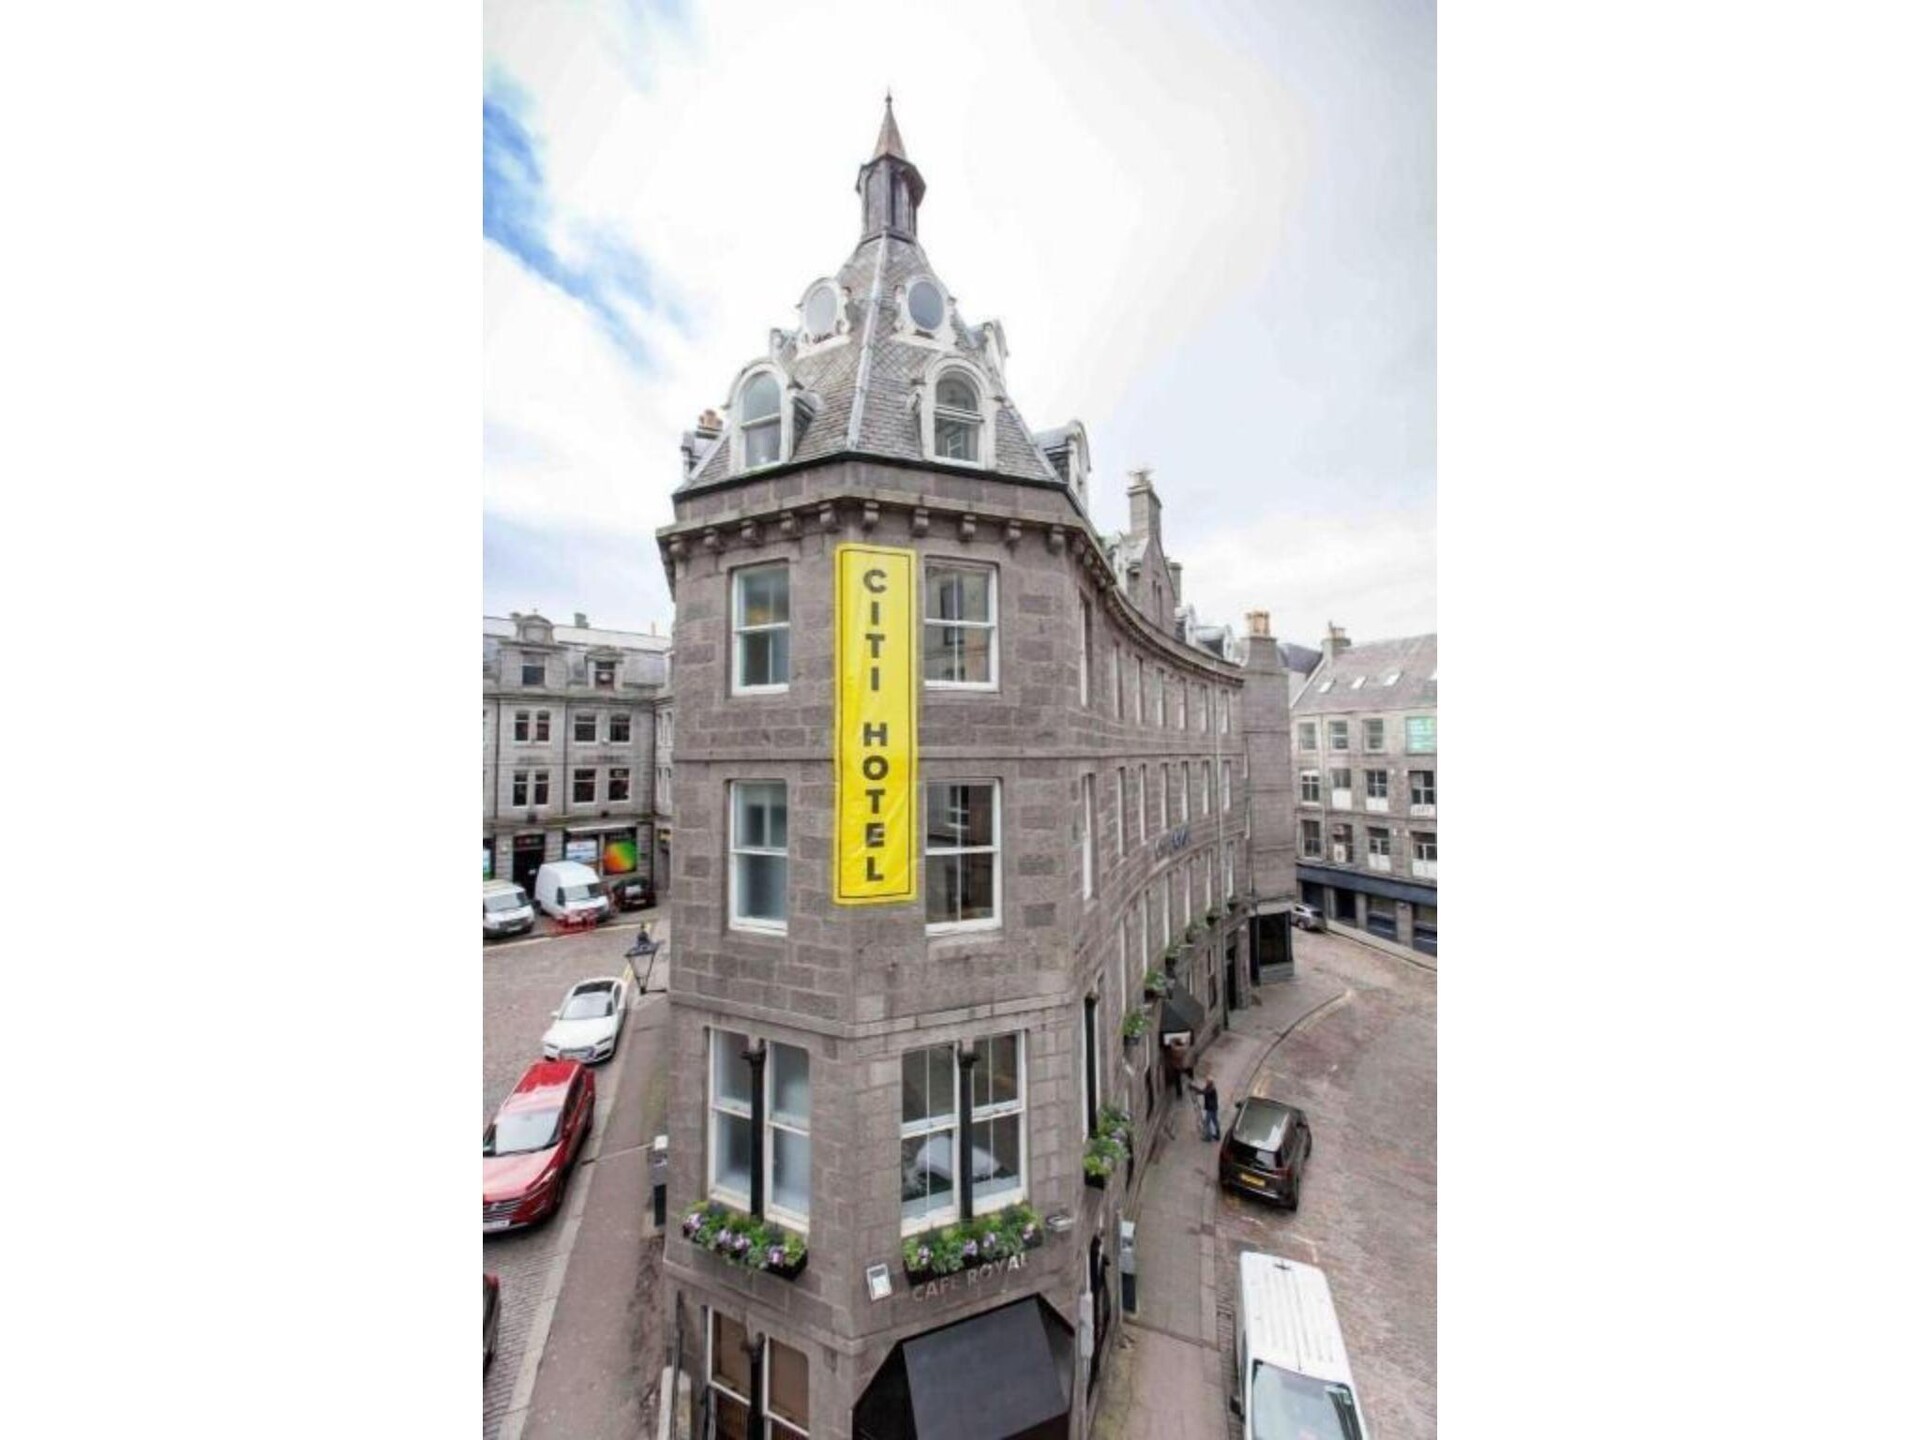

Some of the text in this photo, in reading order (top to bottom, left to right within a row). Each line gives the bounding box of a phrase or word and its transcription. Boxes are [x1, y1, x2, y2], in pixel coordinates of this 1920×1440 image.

[863, 569, 888, 882] CITI HOTEL
[967, 1252, 1028, 1288] ROYAL
